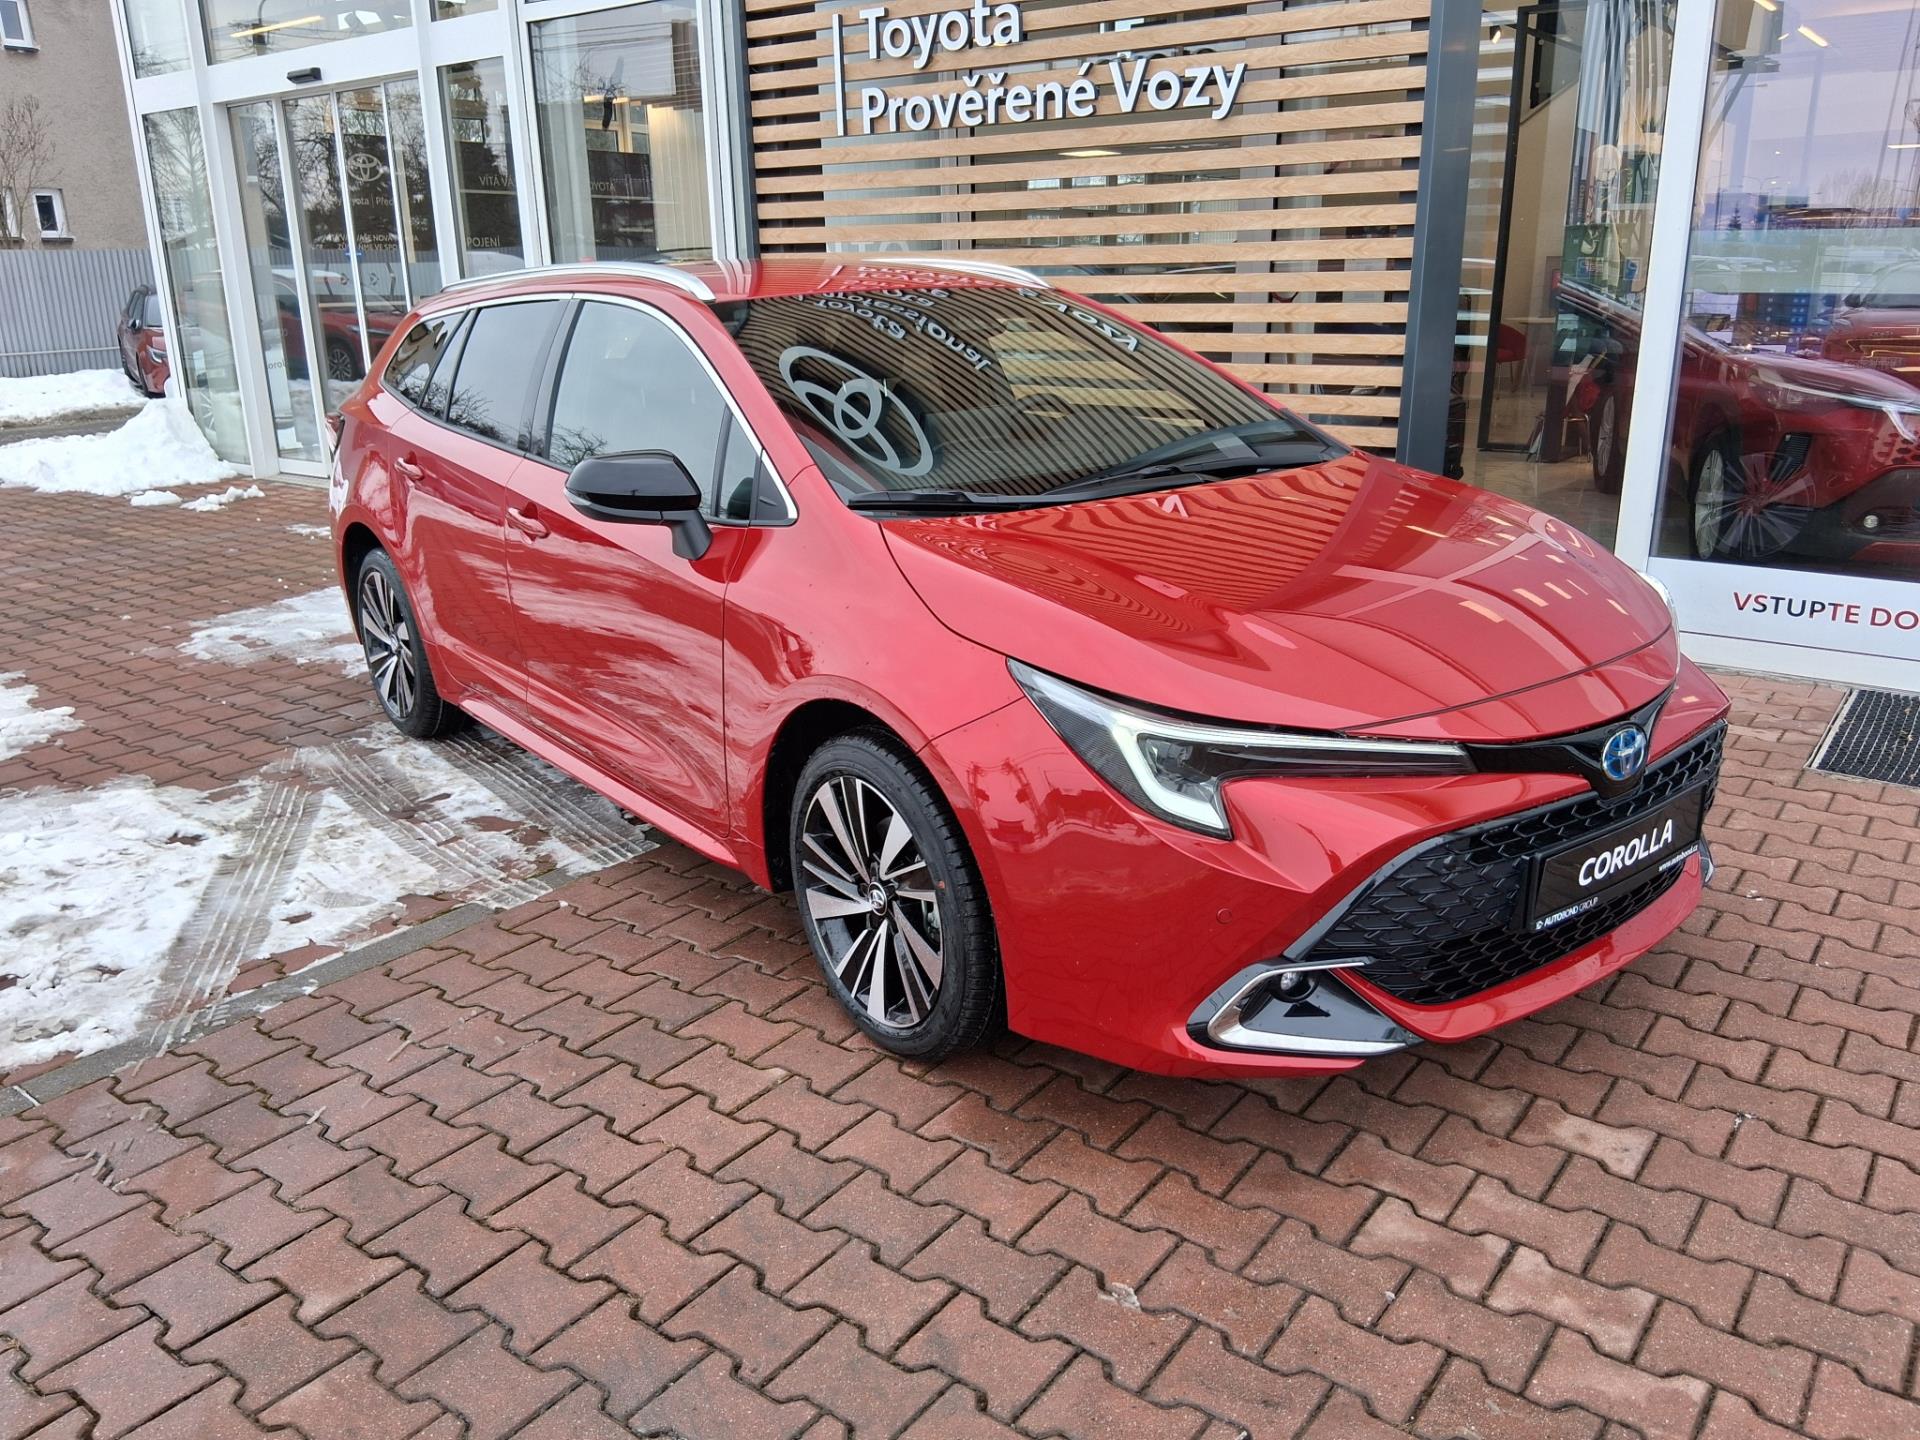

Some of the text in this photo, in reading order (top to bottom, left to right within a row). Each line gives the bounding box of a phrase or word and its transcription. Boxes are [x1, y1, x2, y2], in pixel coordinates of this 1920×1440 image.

[859, 0, 1022, 69] Toyota
[861, 57, 1248, 133] Prověřené Vozy
[466, 234, 500, 248] POJENÍ
[1733, 592, 1920, 630] VSTUPTE DO
[1578, 818, 1673, 887] COROLLA
[1544, 896, 1599, 927] AUTOBOND GROUP
